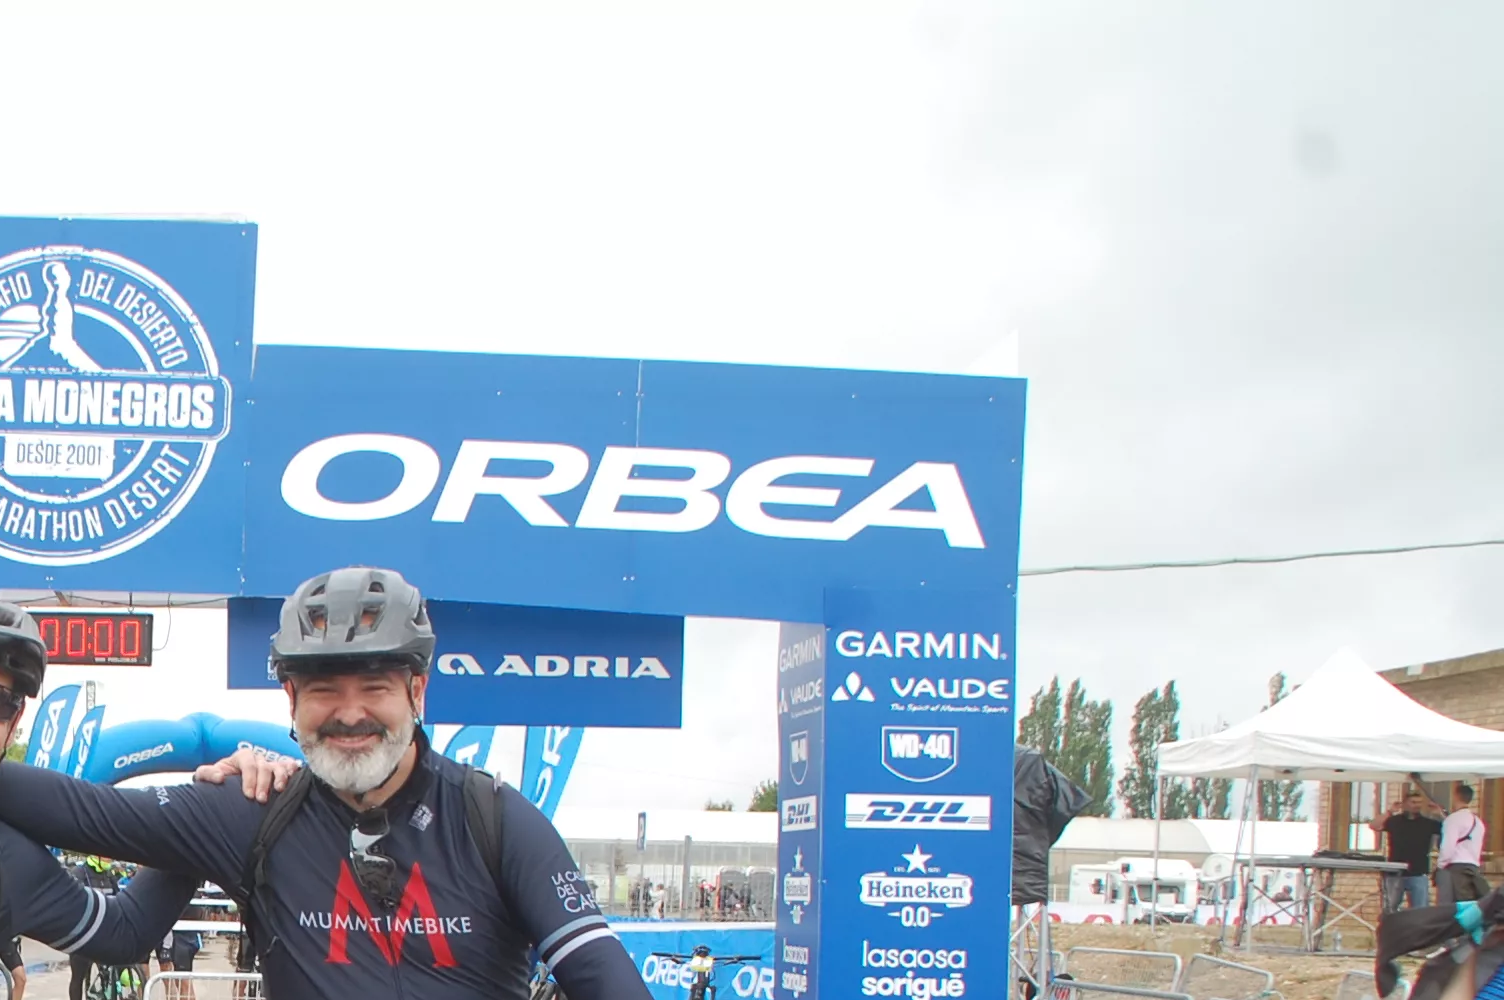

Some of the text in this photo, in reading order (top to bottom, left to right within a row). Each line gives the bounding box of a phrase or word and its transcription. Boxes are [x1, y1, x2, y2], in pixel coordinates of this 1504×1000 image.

[80, 269, 188, 369] DEL DESIERTO
[23, 380, 214, 429] MONEGROS
[16, 440, 102, 466] DESDE 2001
[105, 444, 190, 530] DESERT
[280, 433, 986, 549] ORBEA
[494, 655, 671, 679] ADRIA
[890, 677, 1009, 699] VAUDE
[114, 742, 174, 769] ORBEA
[865, 801, 973, 825] DHL
[557, 884, 579, 899] DEL
[867, 880, 965, 900] Heineken
[901, 904, 929, 928] 0.0
[862, 939, 967, 969] lasaosa
[642, 956, 698, 990] ORBE
